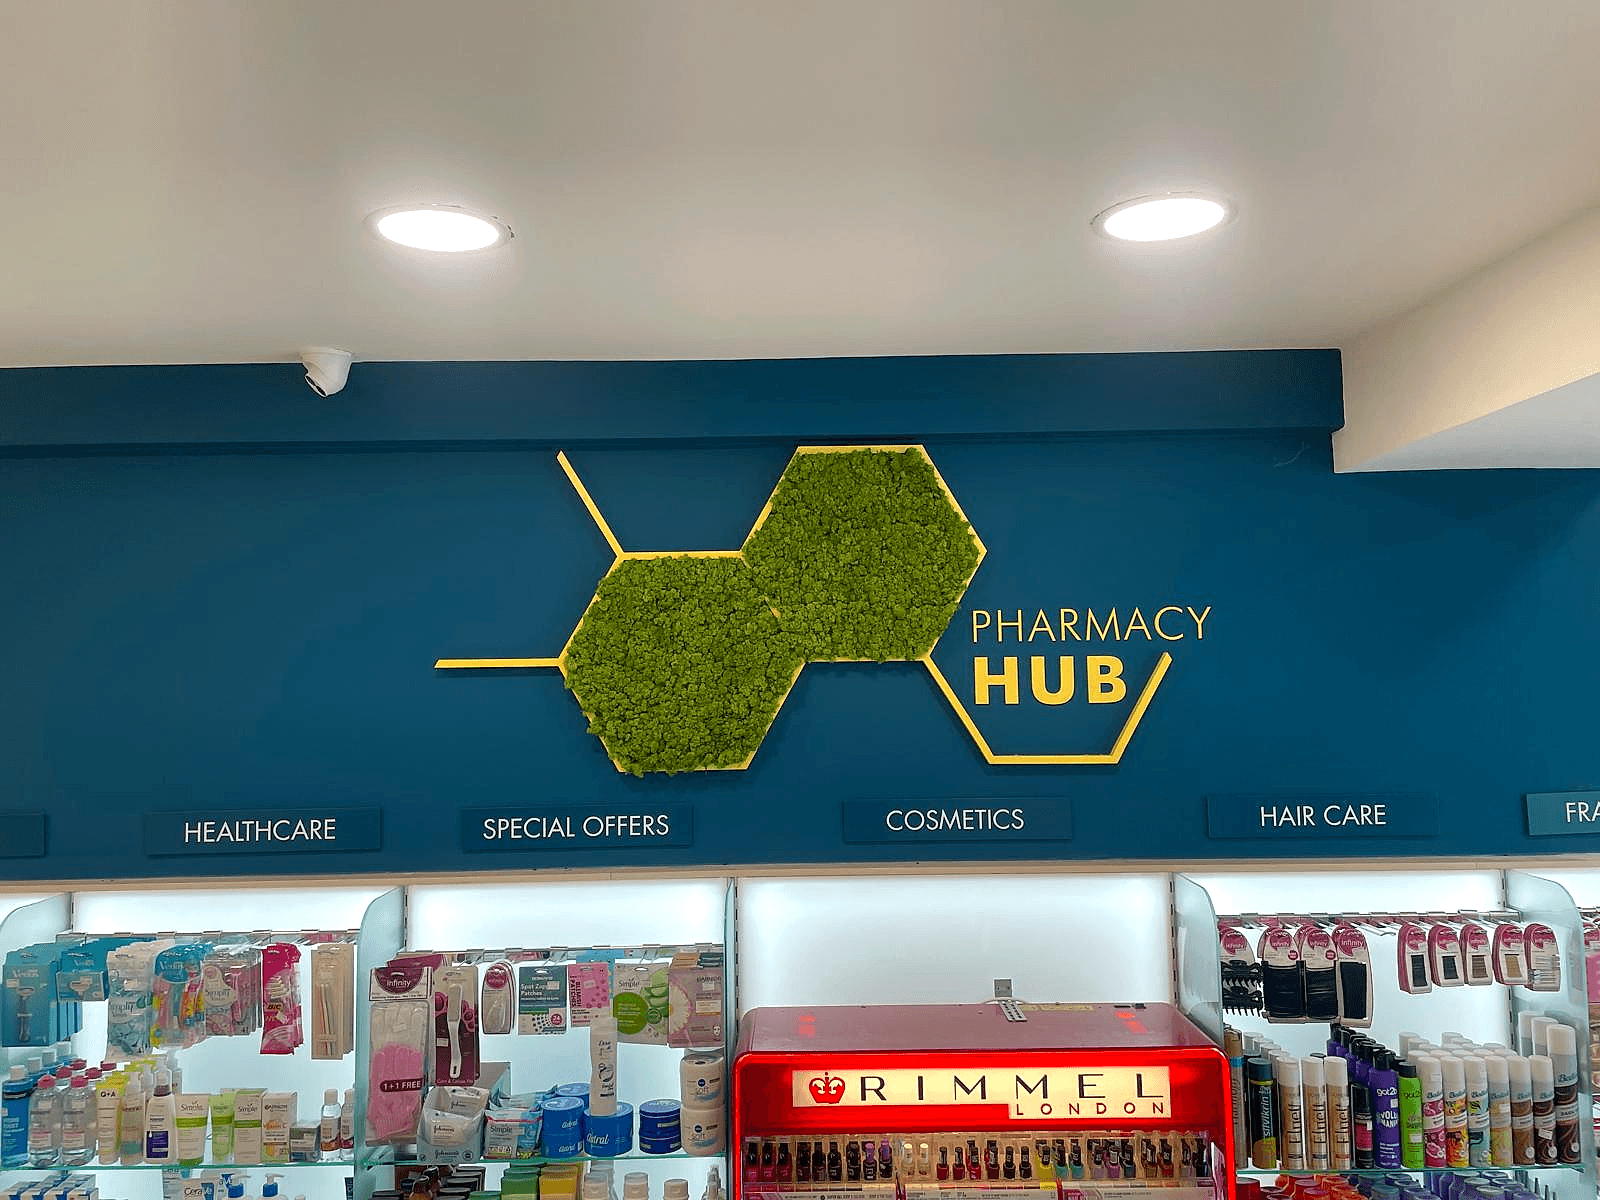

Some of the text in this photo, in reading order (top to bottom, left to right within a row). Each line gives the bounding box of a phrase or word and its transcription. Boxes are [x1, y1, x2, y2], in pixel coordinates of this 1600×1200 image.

[971, 606, 1212, 643] PHARMACY
[974, 655, 1127, 705] HUB
[482, 814, 670, 841] SPECIAL OFFERS
[886, 808, 1025, 832] COSMETICS
[1260, 804, 1387, 828] HAIR CARE
[184, 818, 336, 843] HEALTHCARE
[383, 1080, 421, 1090] 1+1 FREE
[860, 1073, 1165, 1102] RIMMEL
[1016, 1102, 1165, 1116] LONDON
